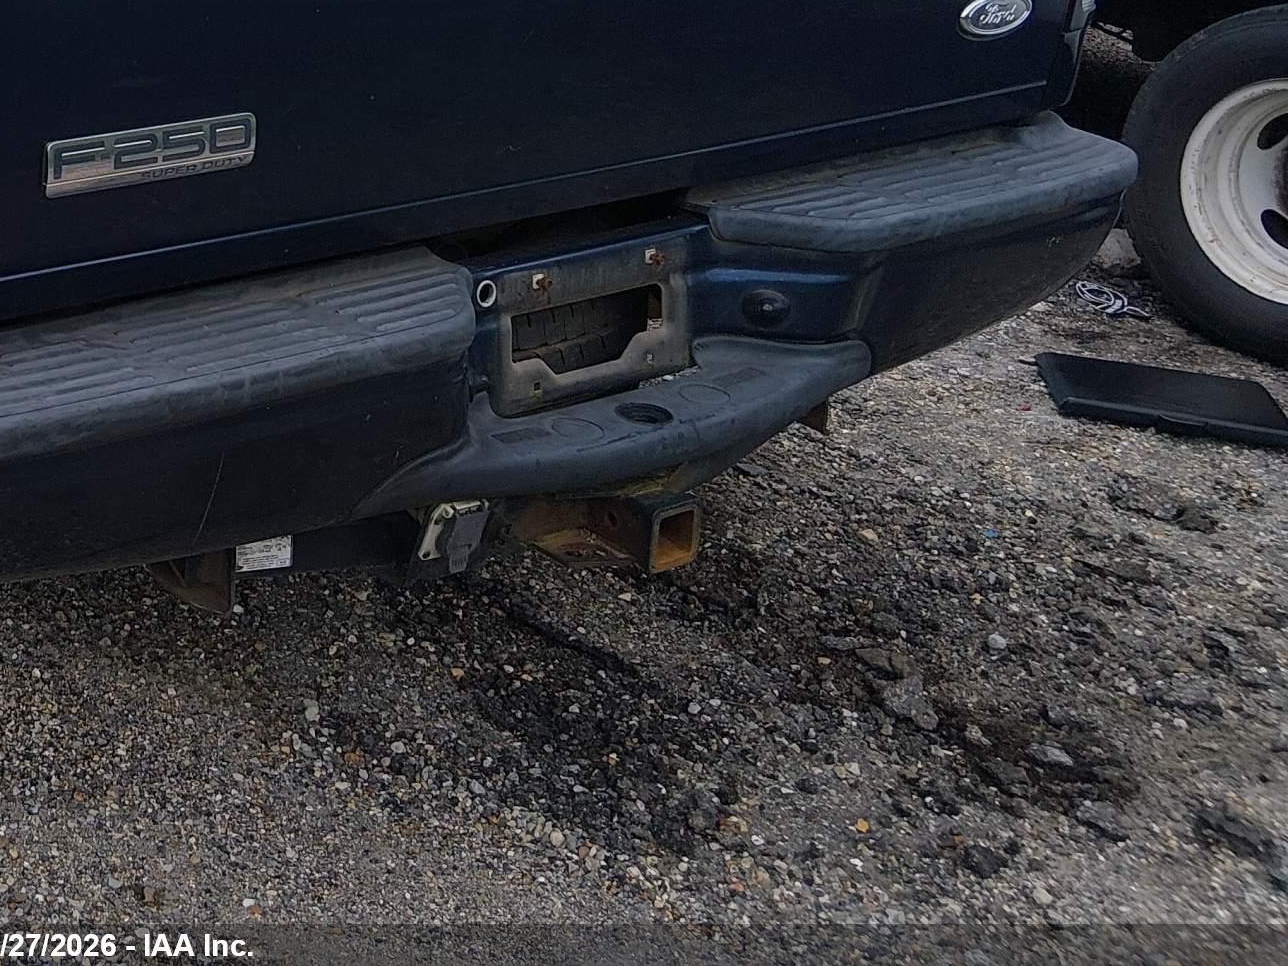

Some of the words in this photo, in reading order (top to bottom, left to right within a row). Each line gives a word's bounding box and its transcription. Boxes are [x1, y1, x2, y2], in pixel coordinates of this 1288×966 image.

[979, 2, 1017, 25] Ford
[141, 164, 197, 179] SUPER
[201, 155, 247, 171] DUTY
